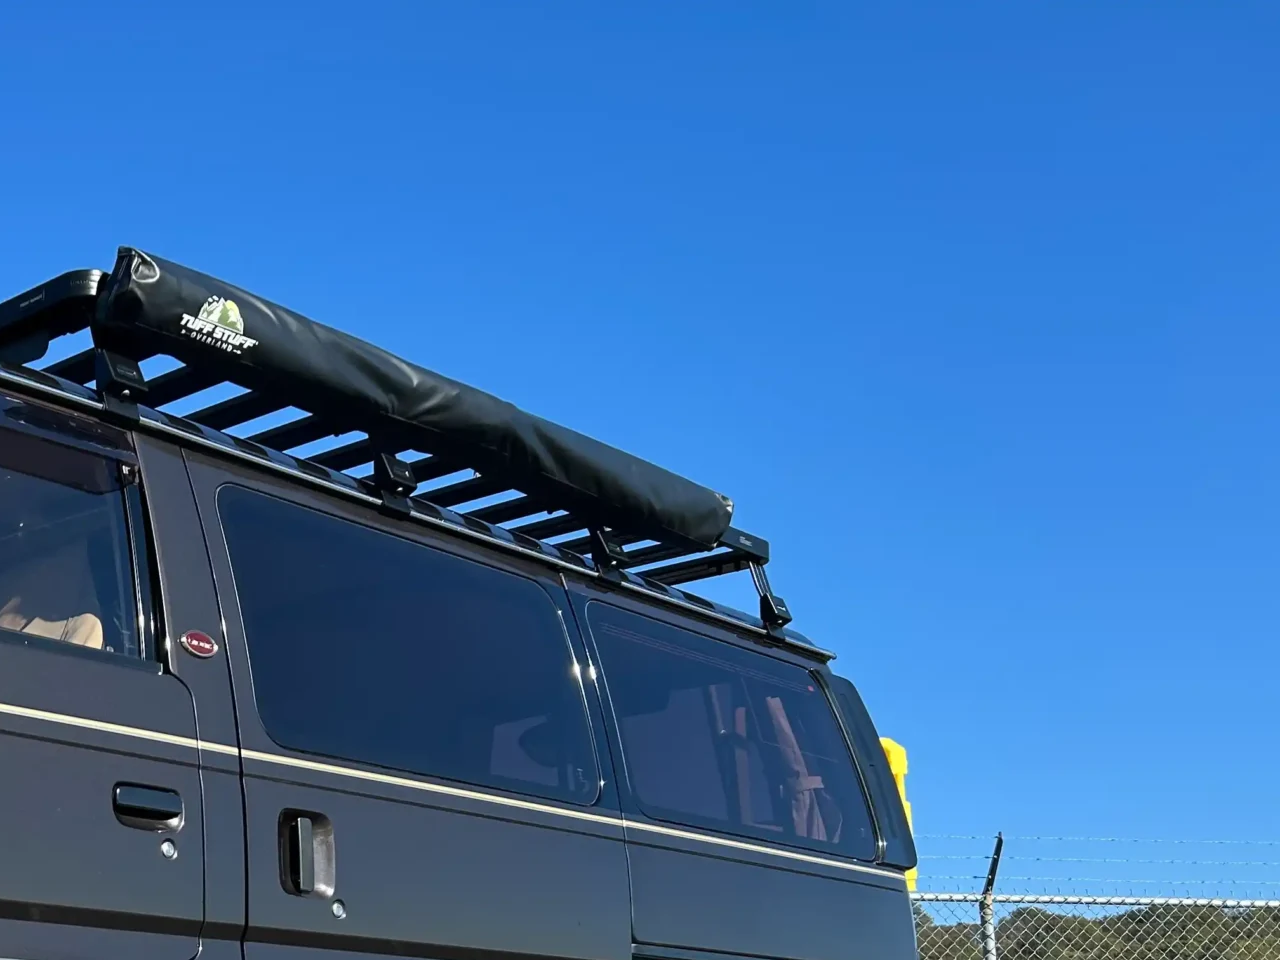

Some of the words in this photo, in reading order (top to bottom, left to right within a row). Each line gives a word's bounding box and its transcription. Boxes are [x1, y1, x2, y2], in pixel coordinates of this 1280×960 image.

[180, 313, 215, 334] TUFF
[213, 326, 257, 349] STUFF
[190, 331, 233, 352] OVERLAND
